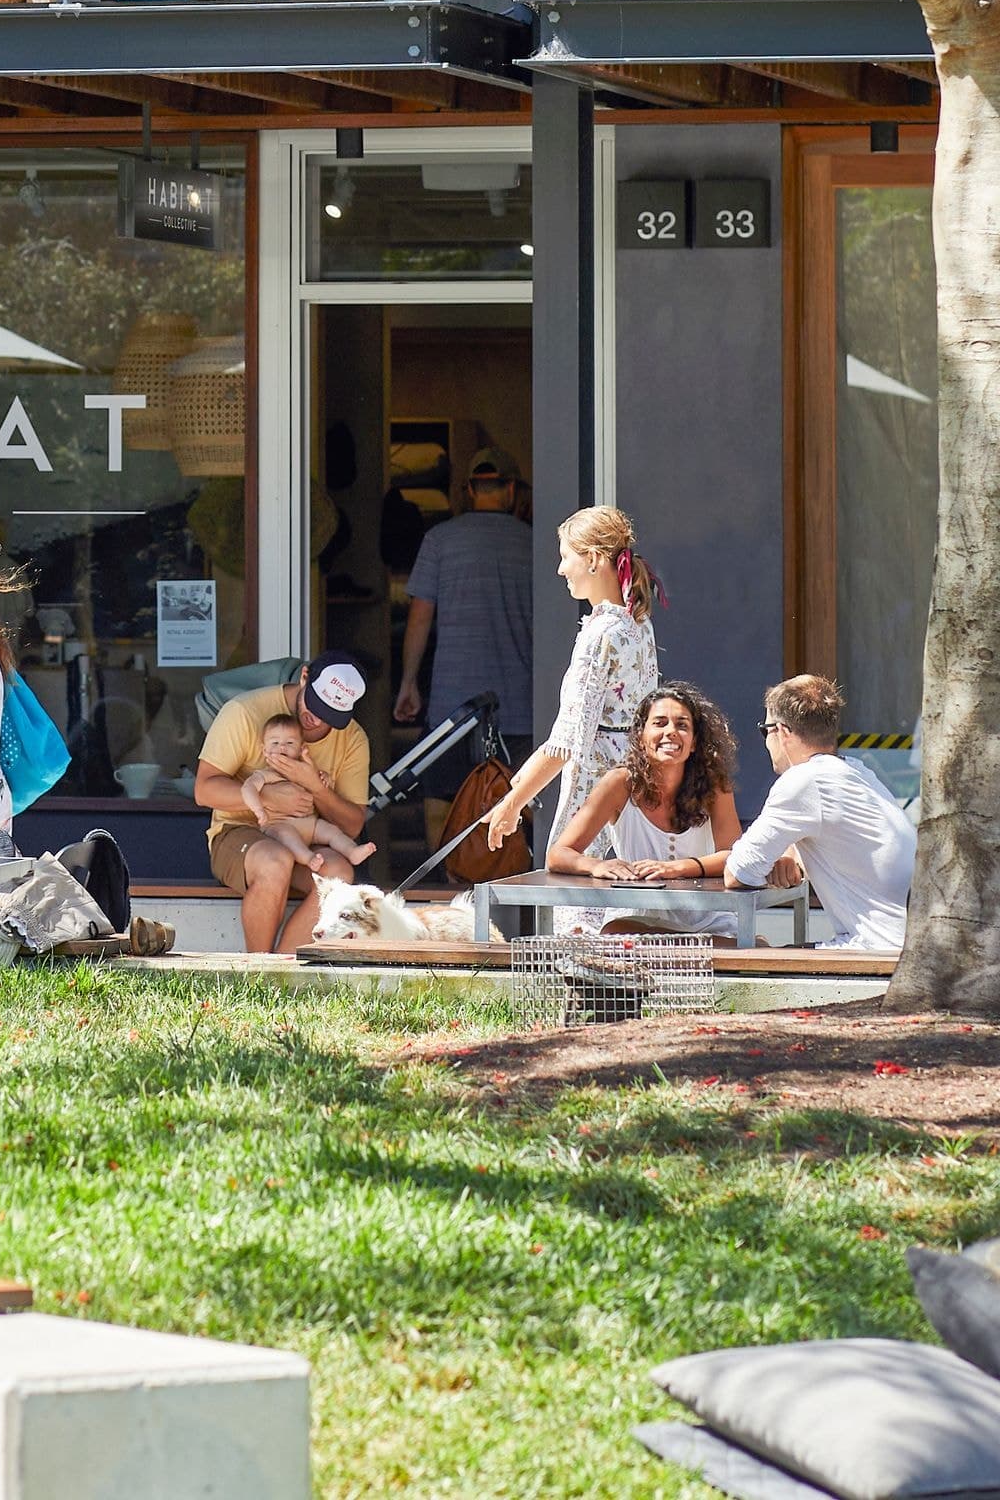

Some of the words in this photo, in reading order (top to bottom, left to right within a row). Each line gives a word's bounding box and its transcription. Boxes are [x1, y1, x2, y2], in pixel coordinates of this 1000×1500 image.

[163, 215, 197, 232] COLLECTIVE
[637, 211, 676, 240] 32
[715, 210, 755, 238] 33
